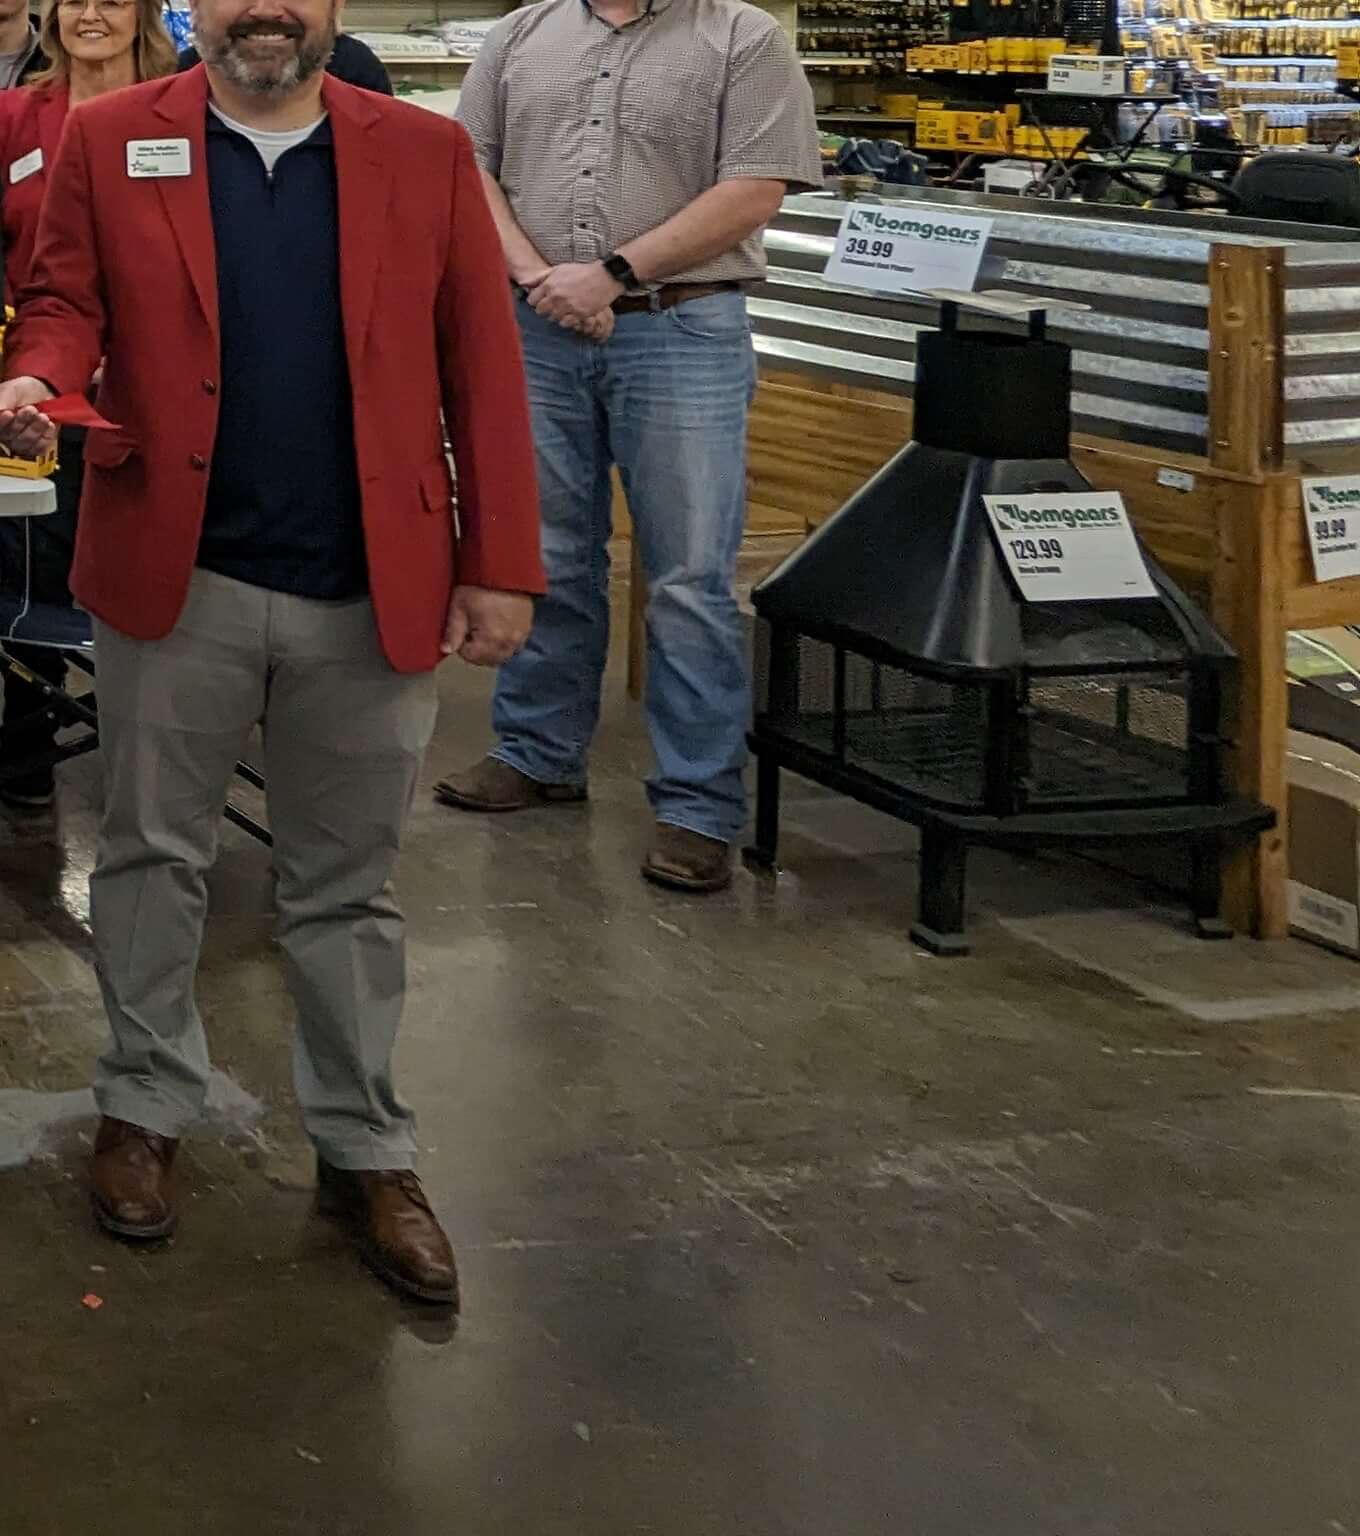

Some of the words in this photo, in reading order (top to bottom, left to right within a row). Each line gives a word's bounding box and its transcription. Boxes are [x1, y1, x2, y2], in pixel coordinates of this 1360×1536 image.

[874, 212, 981, 241] bomgaars
[845, 237, 894, 259] 39.99
[1014, 503, 1120, 529] bomgaars
[1011, 538, 1063, 559] 129.99
